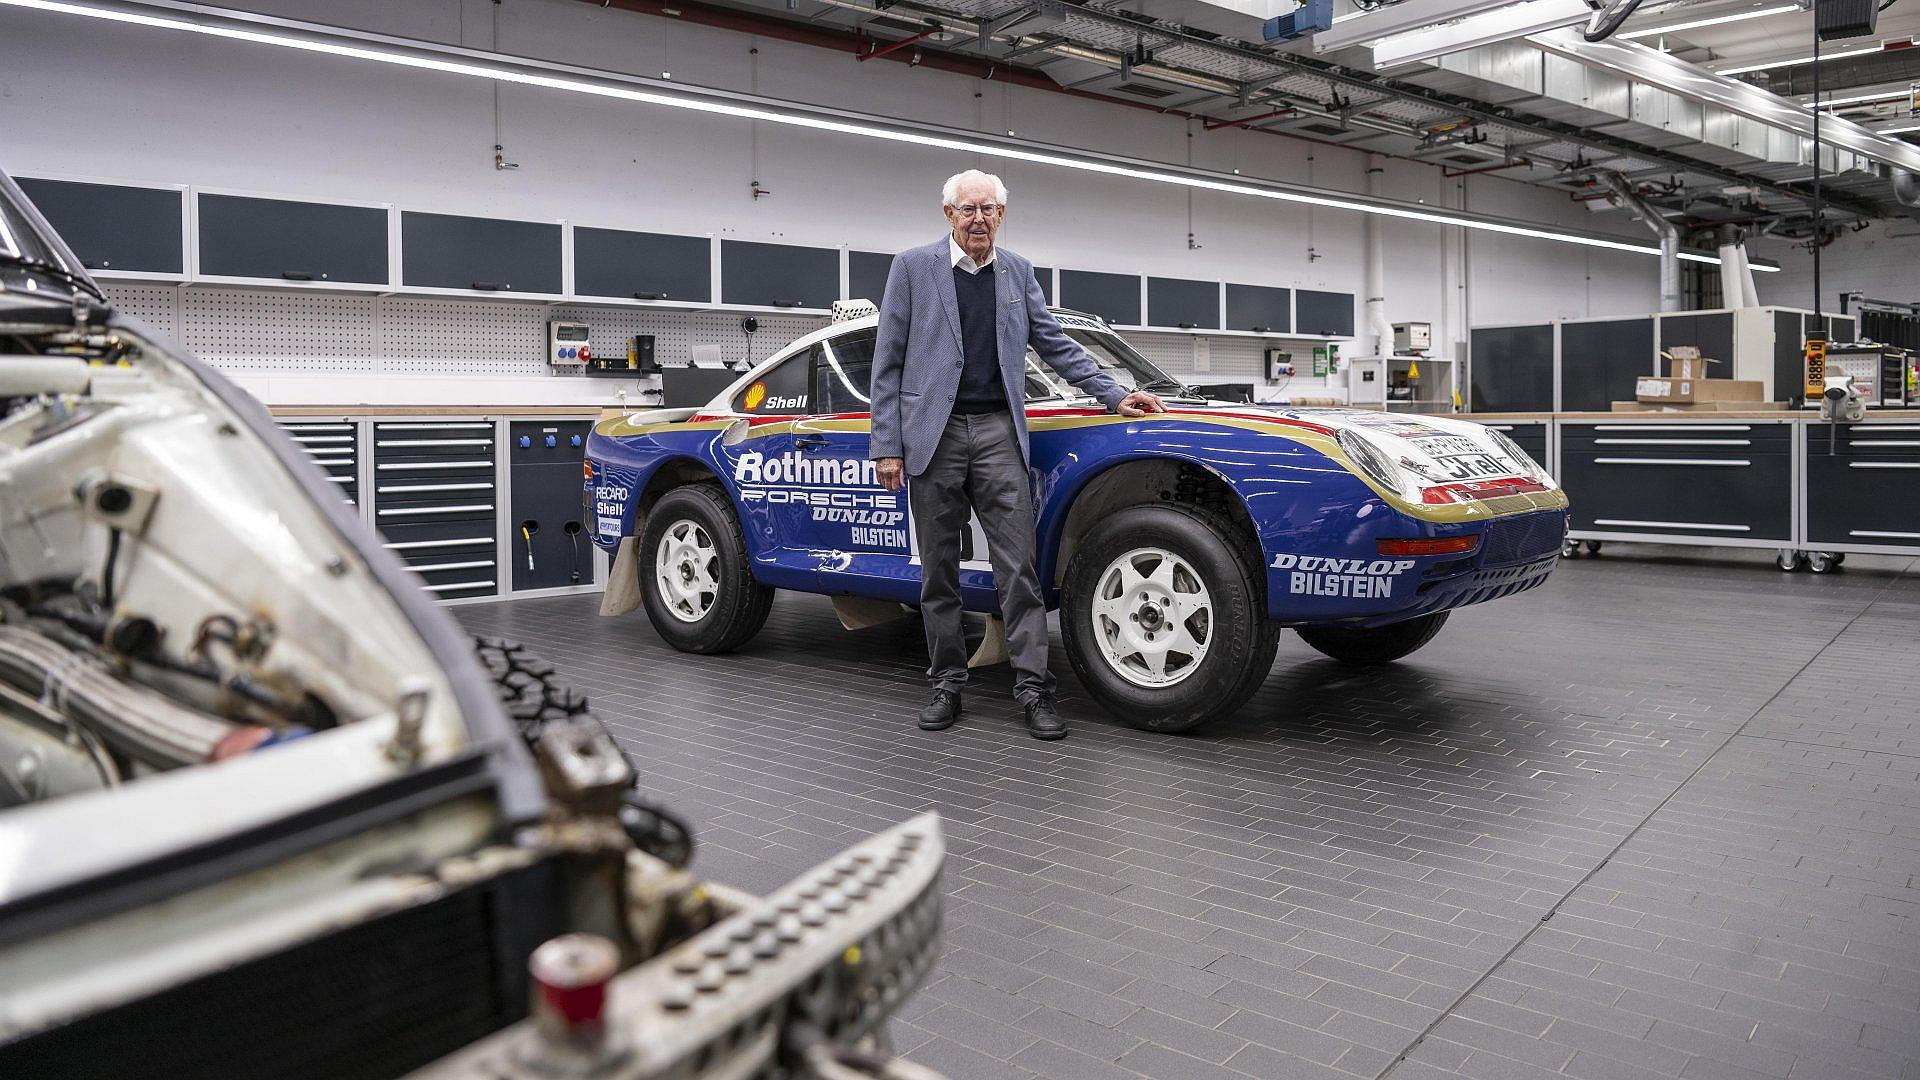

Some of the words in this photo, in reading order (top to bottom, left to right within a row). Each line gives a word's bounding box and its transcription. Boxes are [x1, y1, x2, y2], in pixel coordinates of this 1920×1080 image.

[765, 395, 808, 409] Shell
[735, 450, 882, 485] Rothman
[596, 486, 628, 501] RECARO
[740, 489, 897, 509] PORSCHE
[597, 501, 623, 516] Shell
[812, 506, 904, 526] DUNLOP
[851, 526, 907, 548] BILSTEIN
[1270, 553, 1416, 576] DUNLOP
[1290, 571, 1393, 598] BILSTEIN
